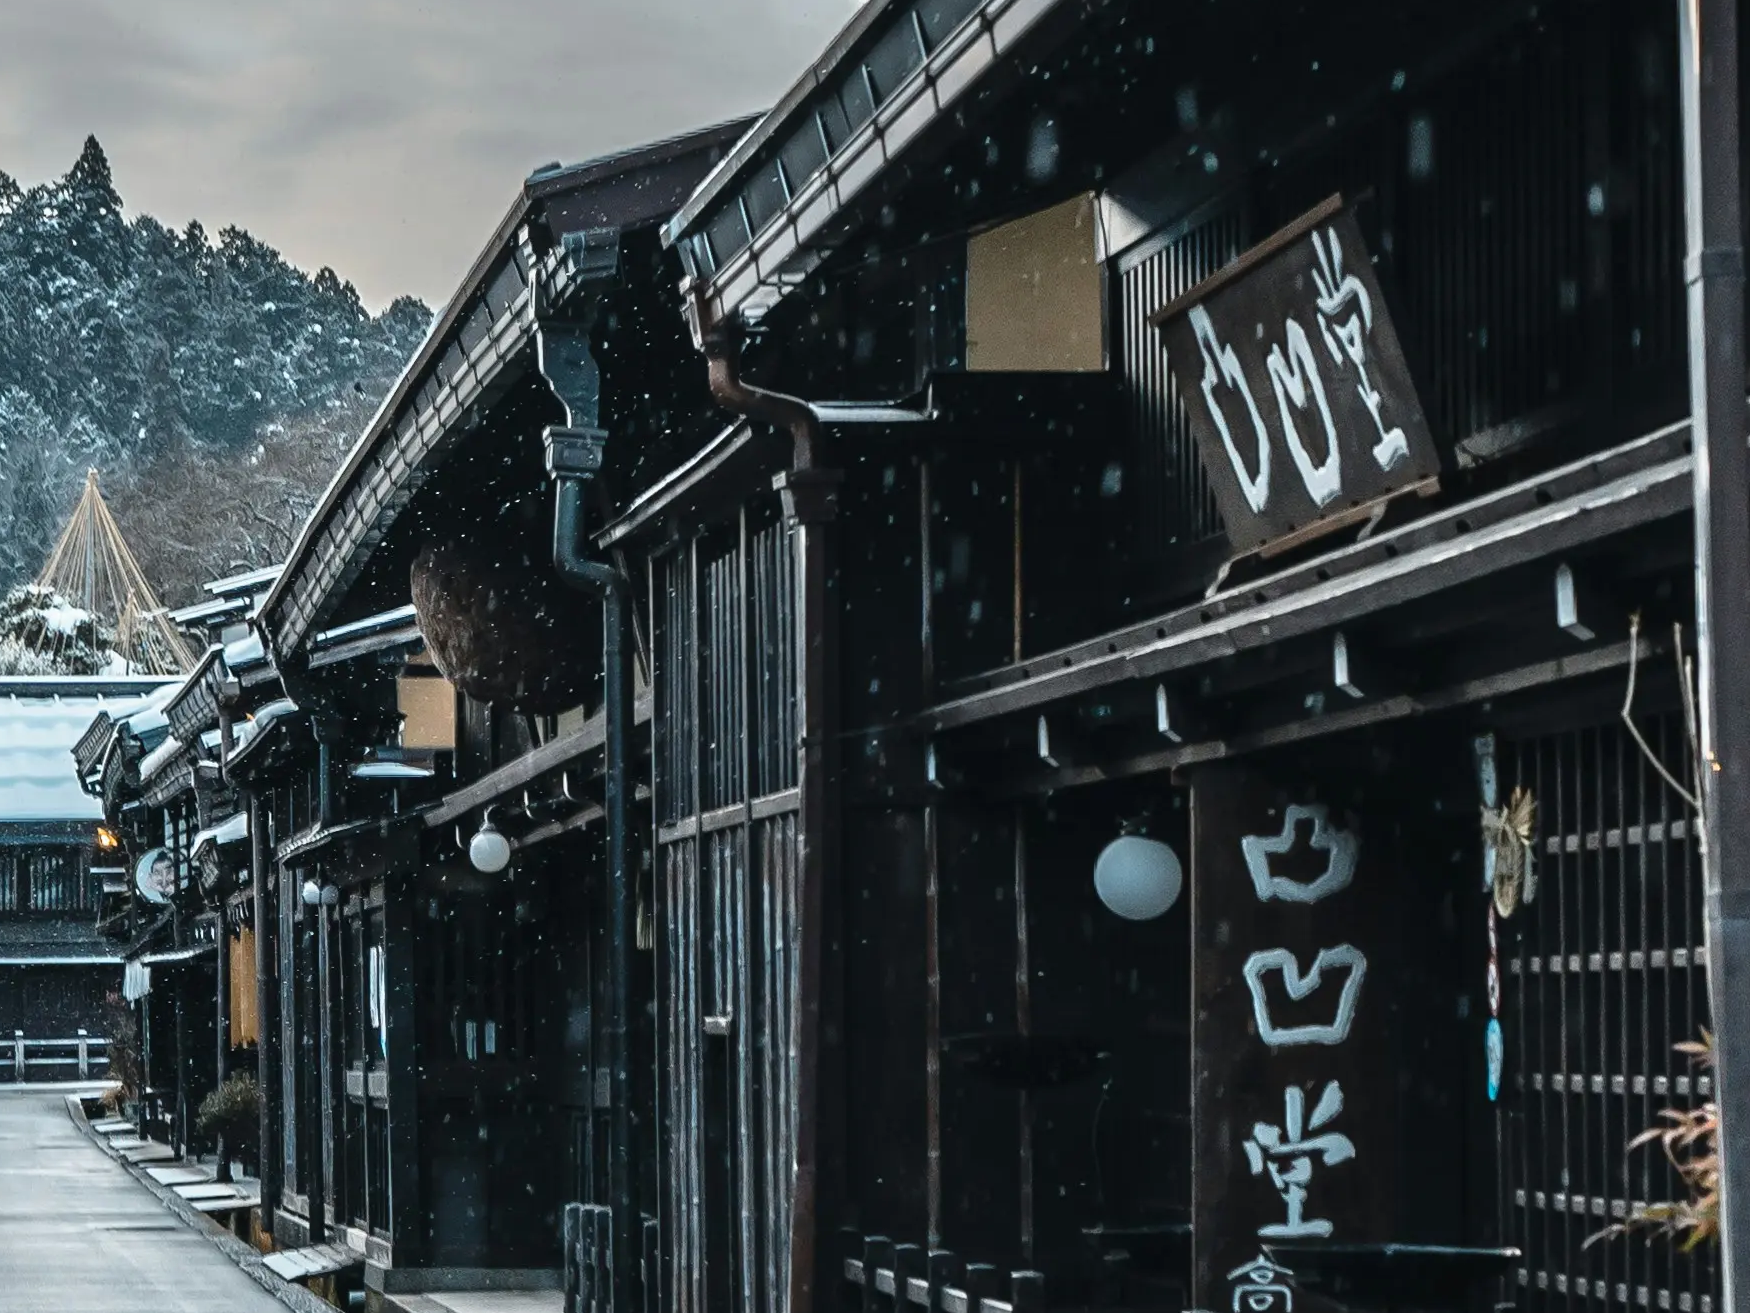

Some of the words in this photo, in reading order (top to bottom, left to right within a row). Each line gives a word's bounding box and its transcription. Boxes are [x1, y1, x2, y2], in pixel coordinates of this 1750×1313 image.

[1188, 226, 1411, 514] 凸凹堂
[1241, 804, 1368, 1239] 凸凹堂
